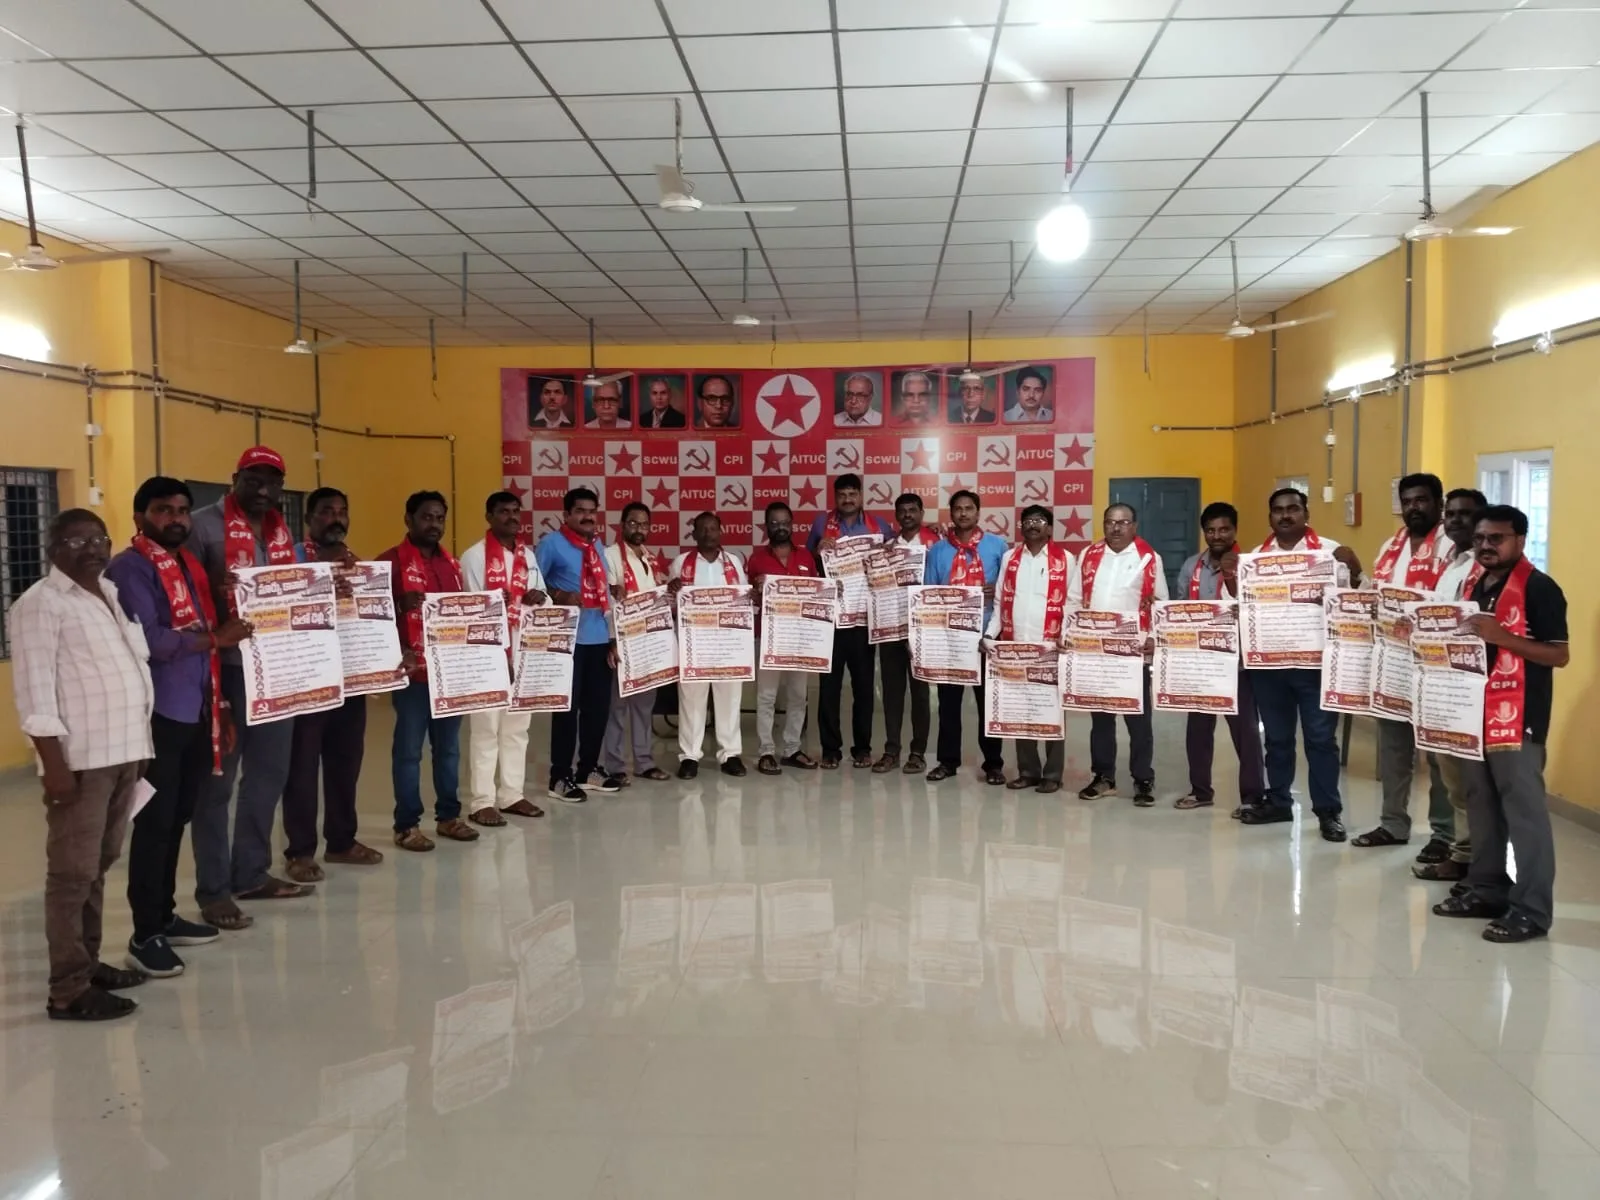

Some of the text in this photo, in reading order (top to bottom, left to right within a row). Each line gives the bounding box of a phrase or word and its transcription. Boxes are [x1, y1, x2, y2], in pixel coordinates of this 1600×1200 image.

[790, 454, 826, 464] AITUC
[865, 455, 900, 464] SCWU
[946, 452, 967, 462] CPI
[1016, 449, 1054, 460] AITUC
[503, 455, 522, 465] CPI
[569, 455, 604, 465] AITUC
[643, 455, 678, 465] SCWU
[723, 455, 743, 465] CPI
[903, 487, 938, 497] AITUC
[979, 485, 1014, 494] SCWU
[1063, 483, 1084, 493] CPI
[613, 489, 633, 499] CPI
[680, 489, 716, 499] AITUC
[754, 489, 788, 498] SCWU
[650, 524, 670, 533] CPI
[230, 531, 252, 540] CPI
[271, 550, 291, 559] CPI
[1409, 564, 1428, 572] CPI
[1491, 680, 1517, 689] CPI
[1490, 729, 1516, 737] CPI
